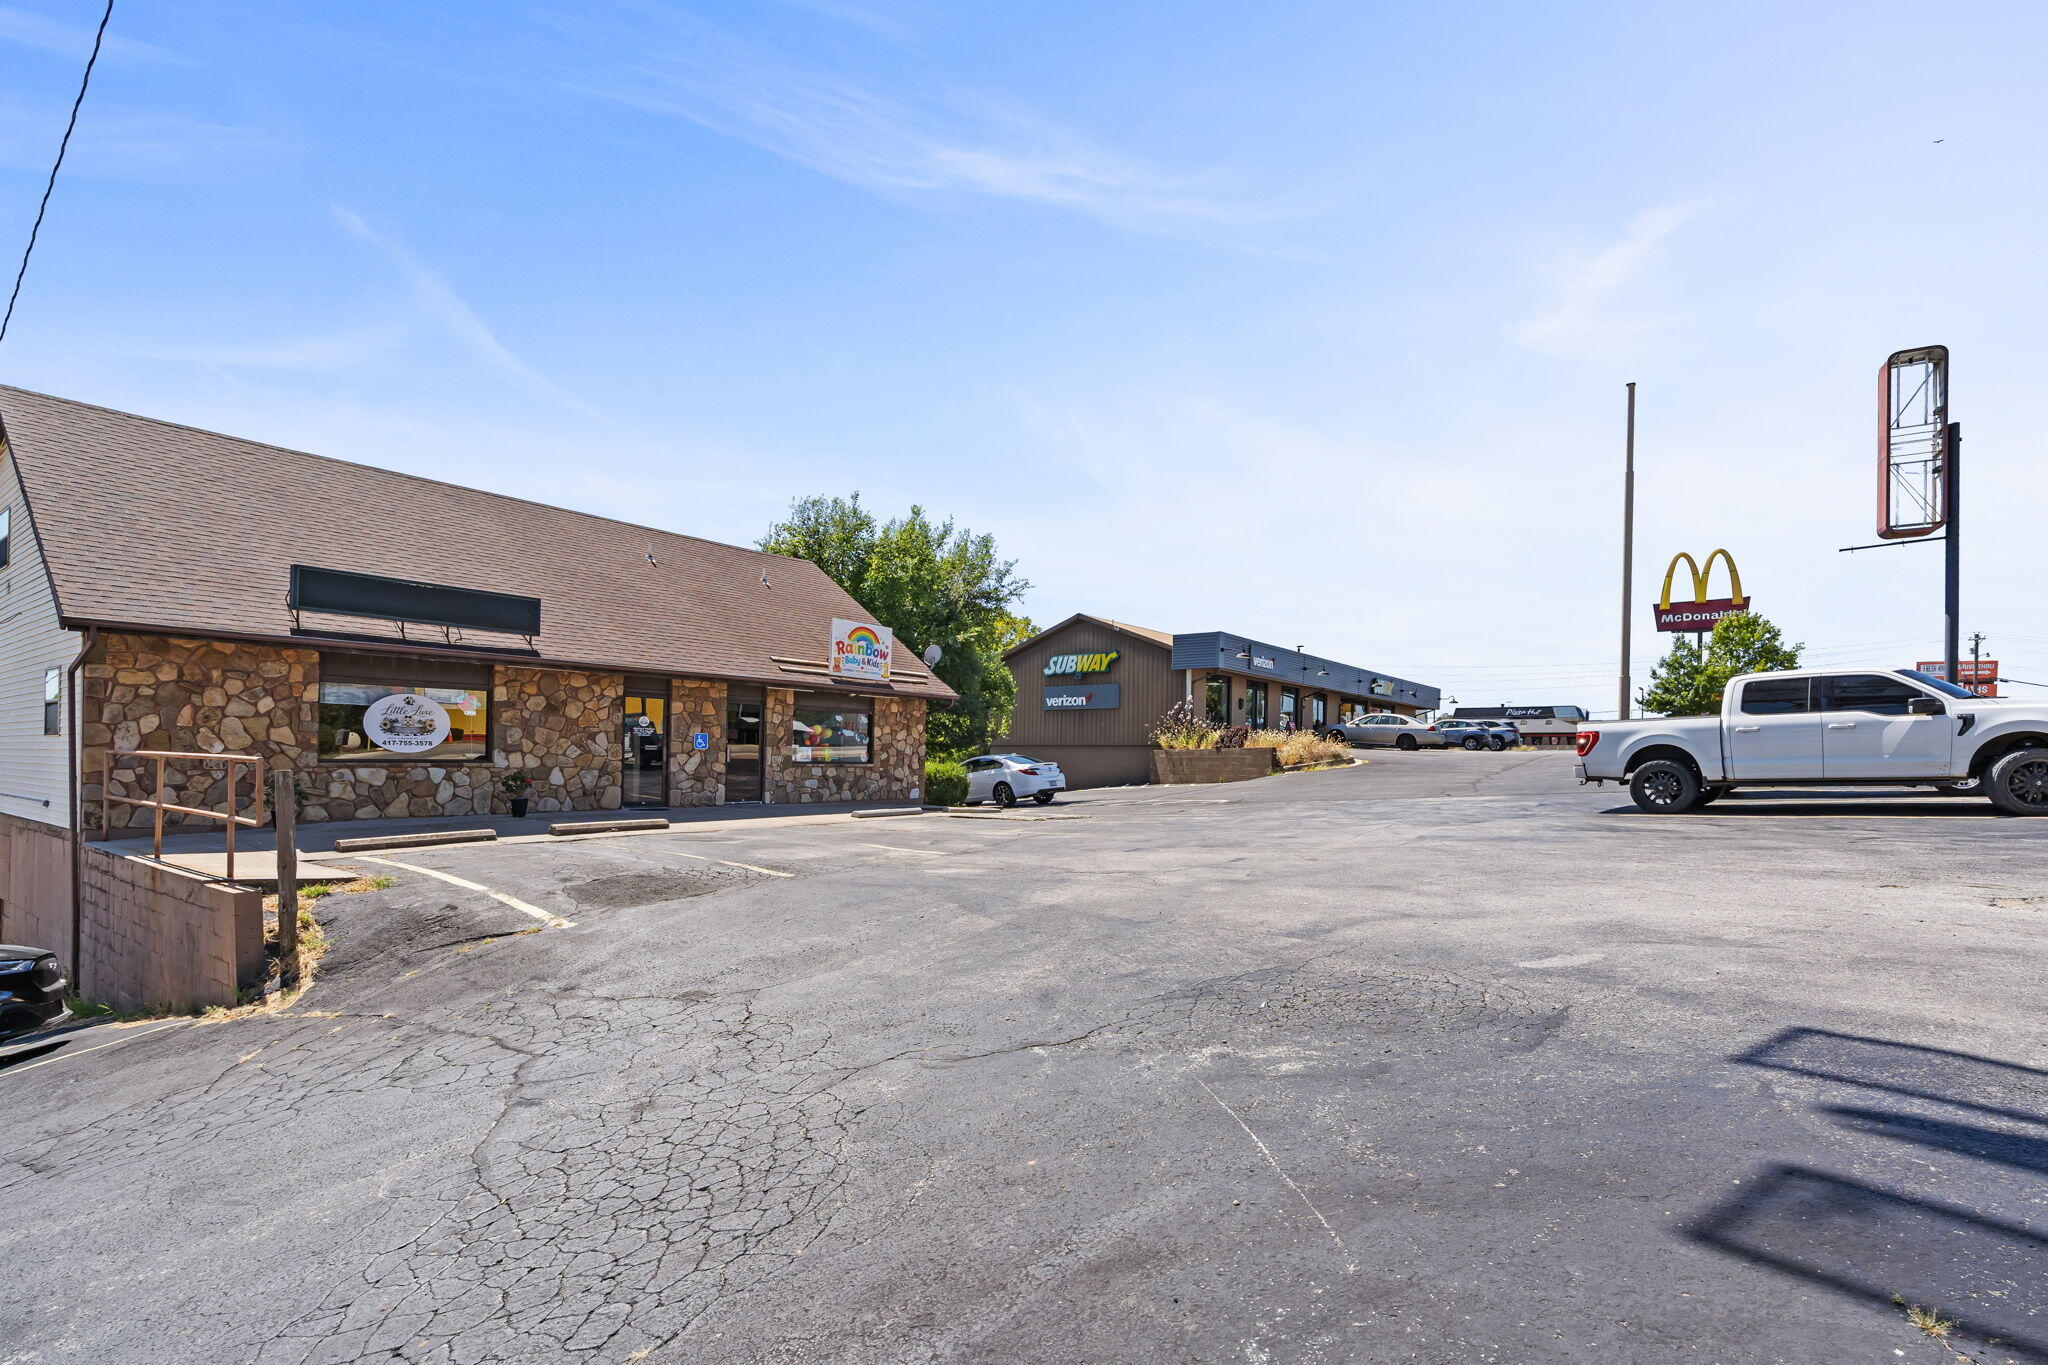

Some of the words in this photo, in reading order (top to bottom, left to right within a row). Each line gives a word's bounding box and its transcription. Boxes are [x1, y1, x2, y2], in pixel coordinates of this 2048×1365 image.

[1661, 609, 1743, 623] McDonalds
[835, 640, 889, 661] Rainbow
[845, 655, 861, 667] Baby
[866, 657, 880, 669] Kids
[1043, 650, 1118, 676] SUBWAY
[1253, 656, 1274, 670] verizon
[1046, 695, 1086, 707] verizon
[1506, 708, 1527, 716] Pizza
